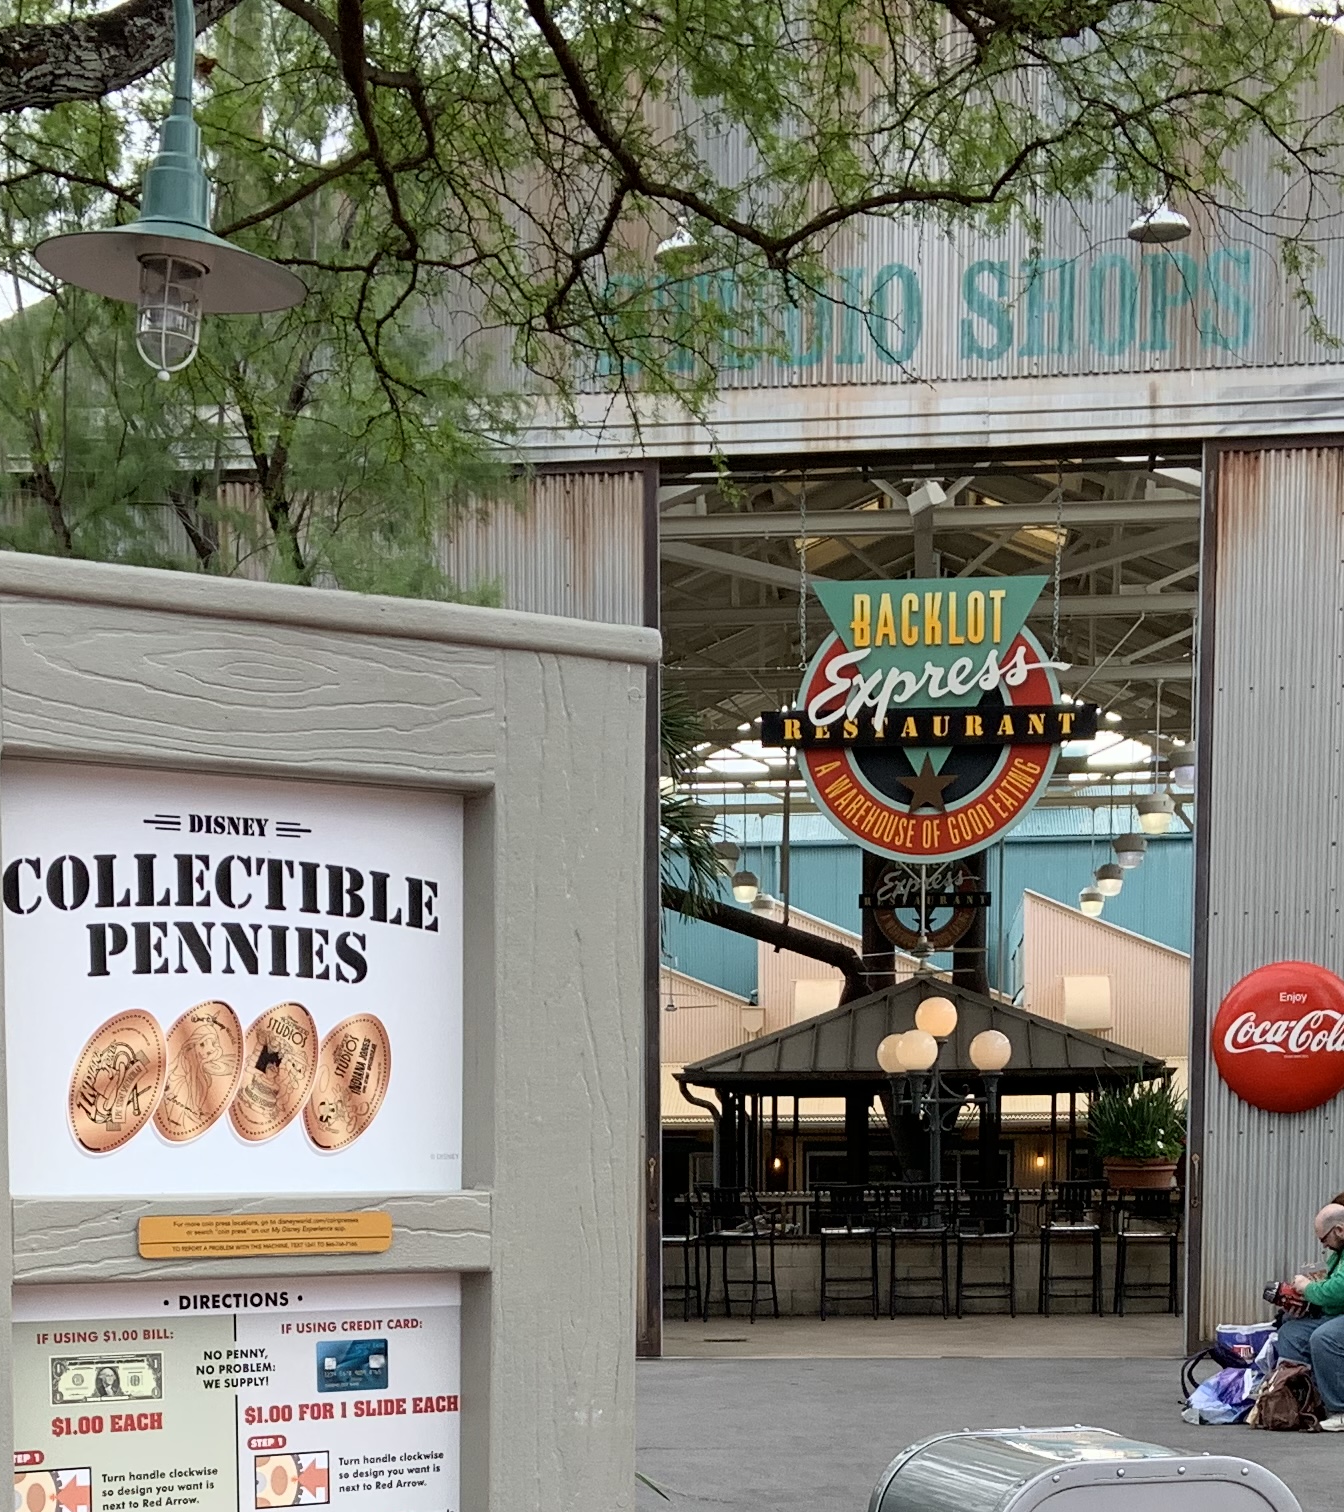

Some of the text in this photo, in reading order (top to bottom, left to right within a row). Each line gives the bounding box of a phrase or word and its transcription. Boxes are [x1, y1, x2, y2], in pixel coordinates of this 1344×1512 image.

[961, 247, 1253, 361] SHOPS
[851, 590, 1006, 647] BACKLOT
[808, 646, 1072, 731] Express
[784, 712, 1075, 740] RESTAURANT
[815, 758, 1041, 848] A WAREHOUSE OF GOOD EATING
[189, 814, 268, 837] DISNEY
[3, 853, 439, 932] COLLECTIBLE
[87, 921, 369, 984] PENNIES
[1280, 992, 1307, 1004] Enjoy
[179, 1292, 289, 1310] DIRECTIONS
[281, 1319, 423, 1334] IF USING CREDIT CARD:
[37, 1329, 174, 1344] IF USING $1.00 BILL:
[203, 1349, 268, 1360] NO PENNY,
[196, 1365, 215, 1375] NO
[203, 1376, 269, 1389] WE SUPPLY!
[245, 1395, 459, 1425] $1.00 FOR 1 SLIDE EACH
[52, 1412, 163, 1437] $1.00 EACH
[250, 1438, 283, 1448] STEP 1
[14, 1453, 40, 1463] TEP 1
[339, 1451, 444, 1465] Turn handle clockwise
[102, 1467, 218, 1483] Turn handle clockwise
[339, 1464, 440, 1480] so design you want is
[102, 1481, 214, 1497] so design you want is
[339, 1479, 427, 1492] next to Red Arrow.
[103, 1496, 199, 1510] next to Red Arrow.
